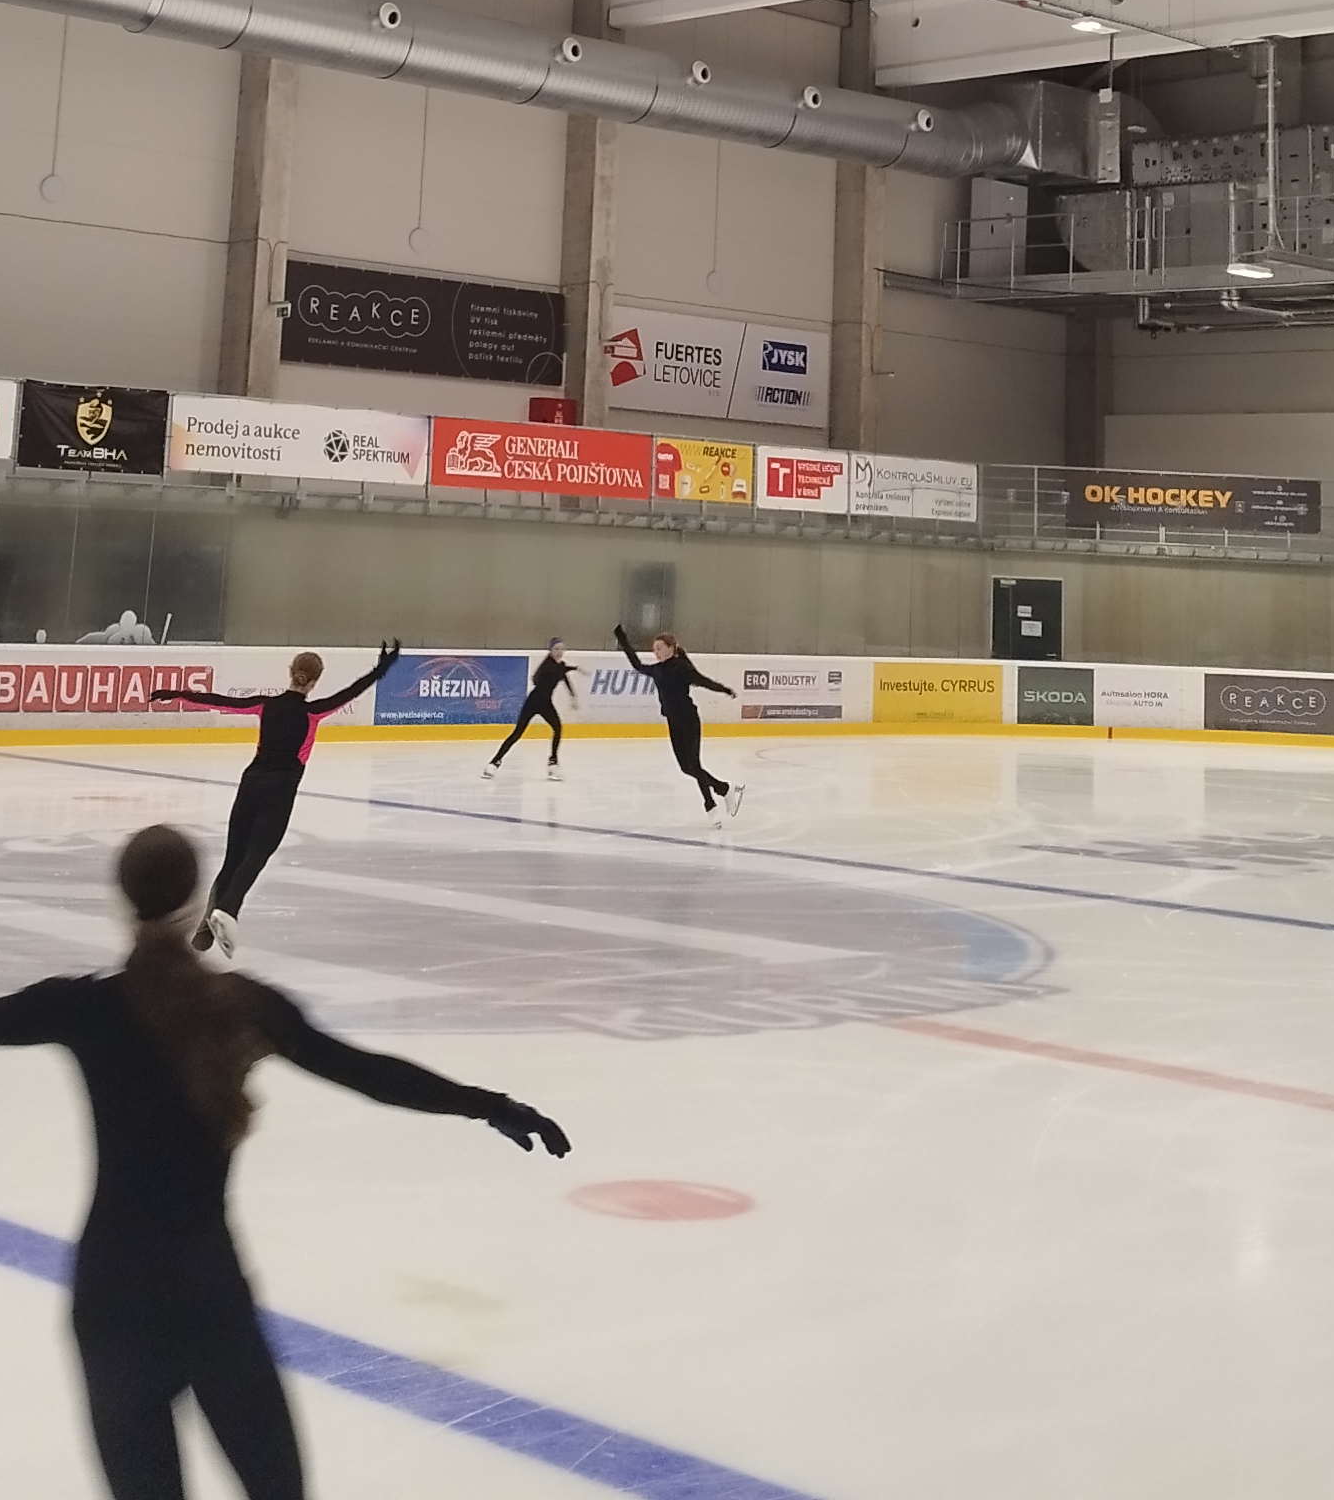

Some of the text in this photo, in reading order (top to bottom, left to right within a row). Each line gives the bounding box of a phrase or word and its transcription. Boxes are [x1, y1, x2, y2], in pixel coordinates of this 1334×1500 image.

[310, 297, 420, 326] REAKCE
[484, 317, 498, 325] tisk
[503, 308, 539, 319] tiskoviny
[655, 341, 722, 366] FUERTES
[771, 348, 806, 368] JYSK
[654, 364, 722, 388] LETOVICE
[187, 416, 301, 440] Prodej a aukce
[184, 441, 281, 461] nemovitostí
[353, 435, 380, 449] REAL
[505, 435, 578, 459] GENERALI
[352, 448, 410, 465] SPEKTRUM
[504, 456, 643, 488] ČESKÁ POJIŠŤOVNA
[855, 490, 883, 500] Kontrola
[1085, 484, 1232, 508] OK HOCKEY
[419, 674, 491, 697] BŘEZINA
[745, 674, 768, 686] ERO
[772, 675, 817, 686] INDUSTRY
[880, 679, 995, 695] Investujte. CYRRUS
[1143, 691, 1169, 699] HORA
[1229, 693, 1317, 709] REAKCE
